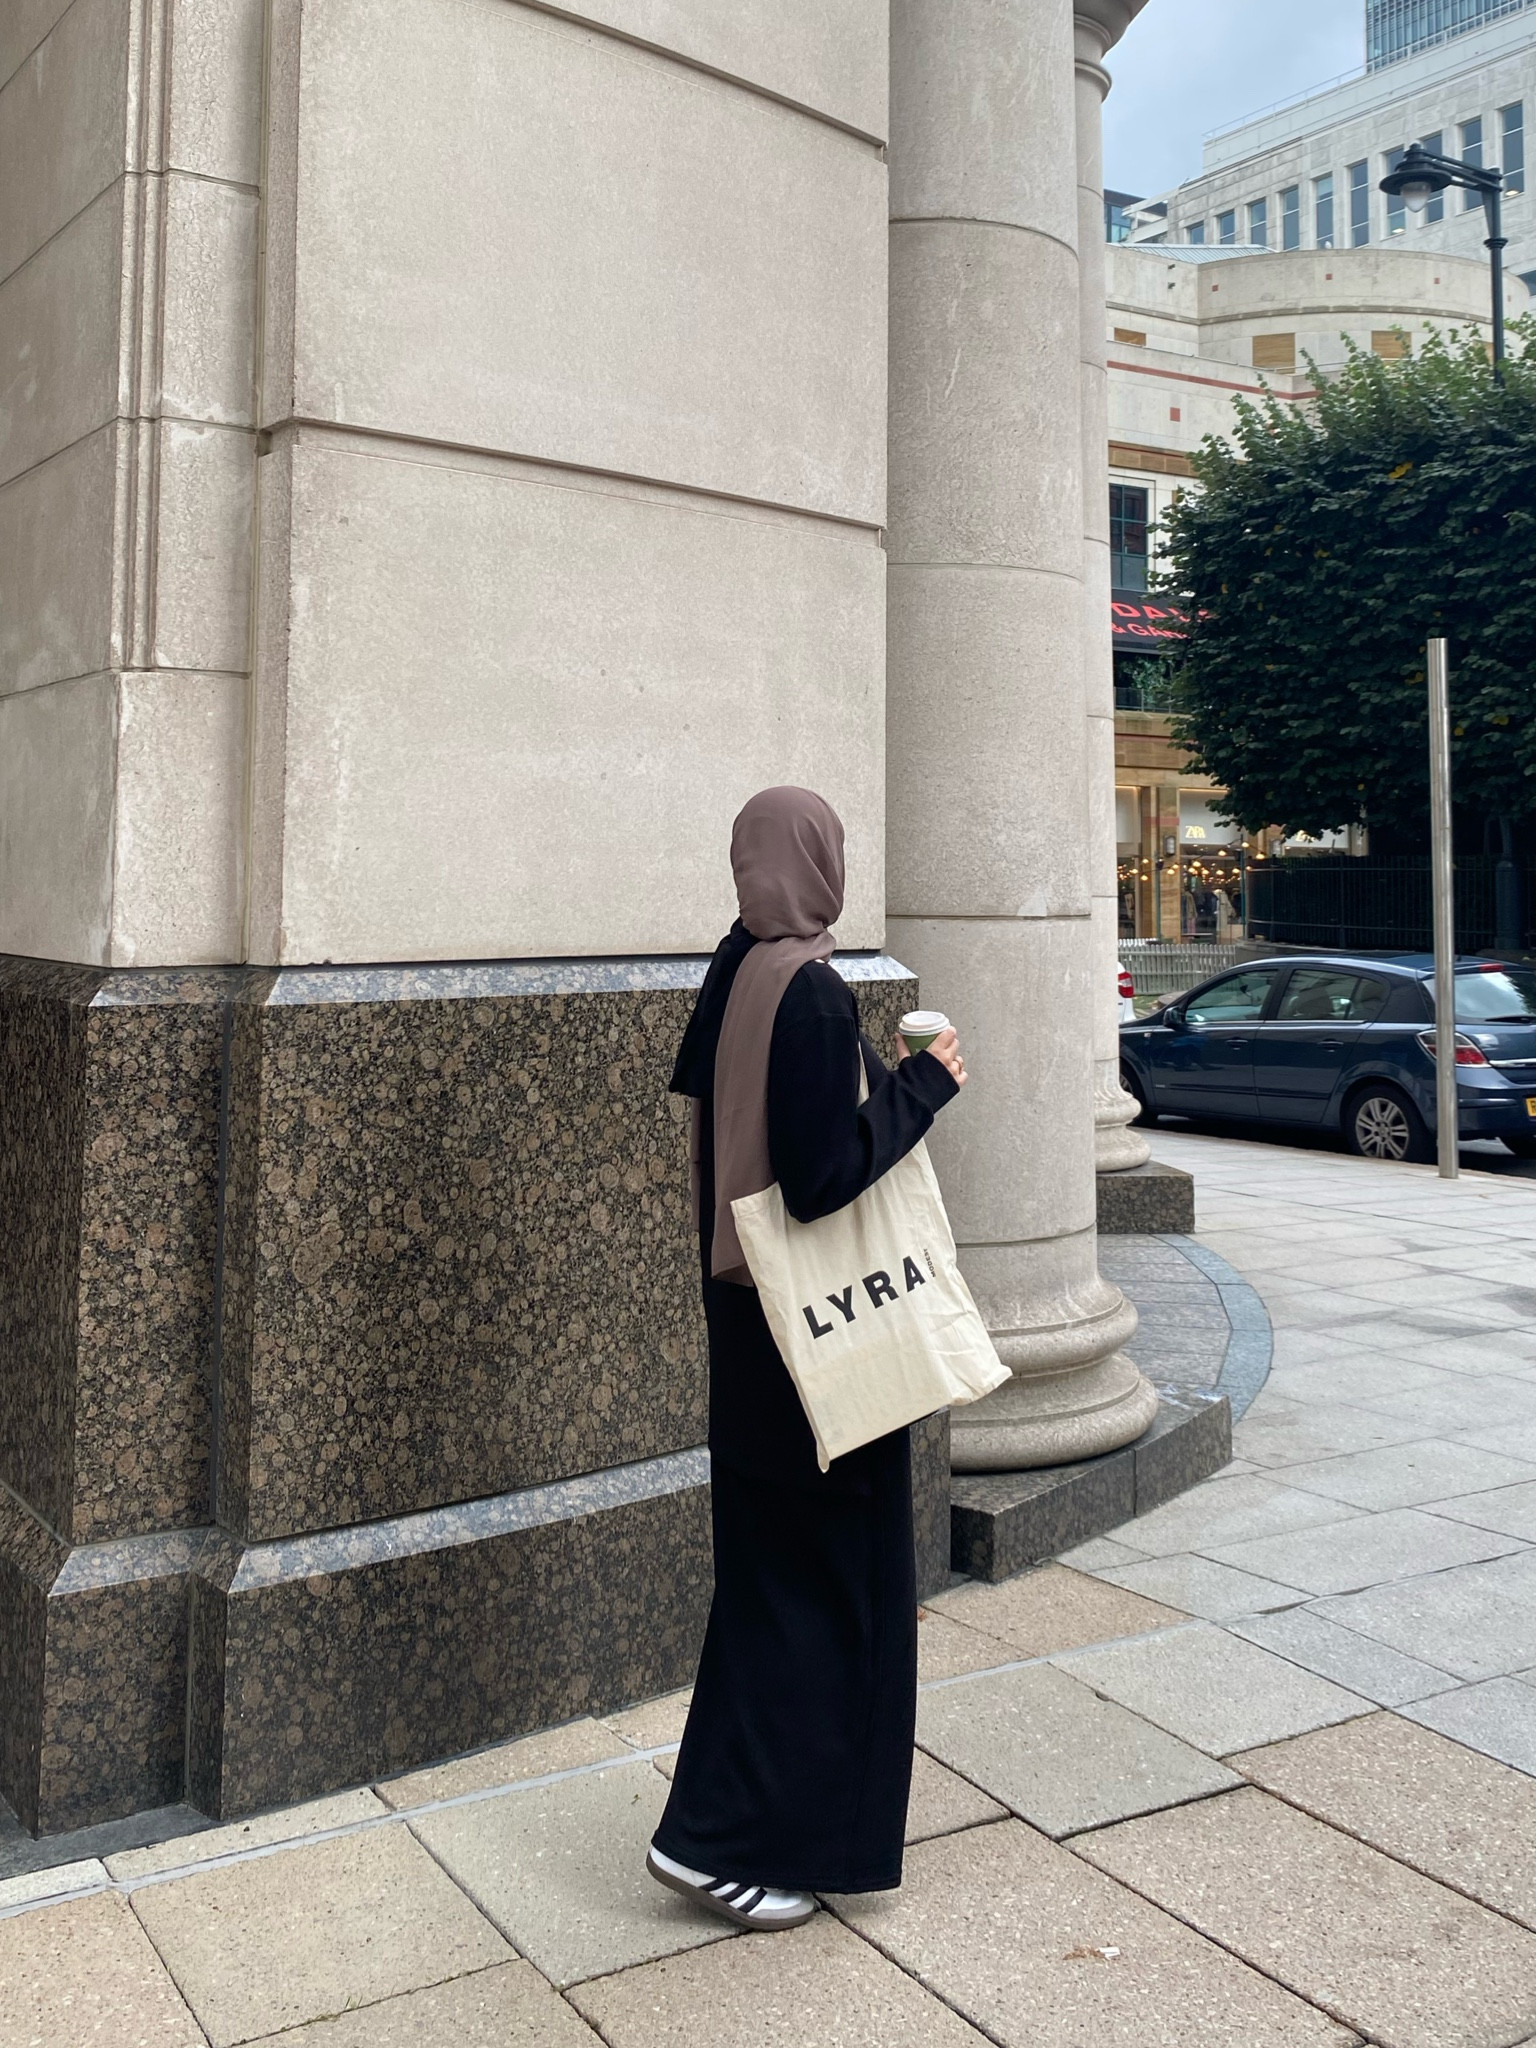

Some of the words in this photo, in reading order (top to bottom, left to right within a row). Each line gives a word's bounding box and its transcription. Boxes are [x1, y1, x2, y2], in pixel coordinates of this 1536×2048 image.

[1185, 825, 1206, 839] ZARA
[923, 1248, 937, 1278] MODEST
[802, 1255, 926, 1340] LYRA
